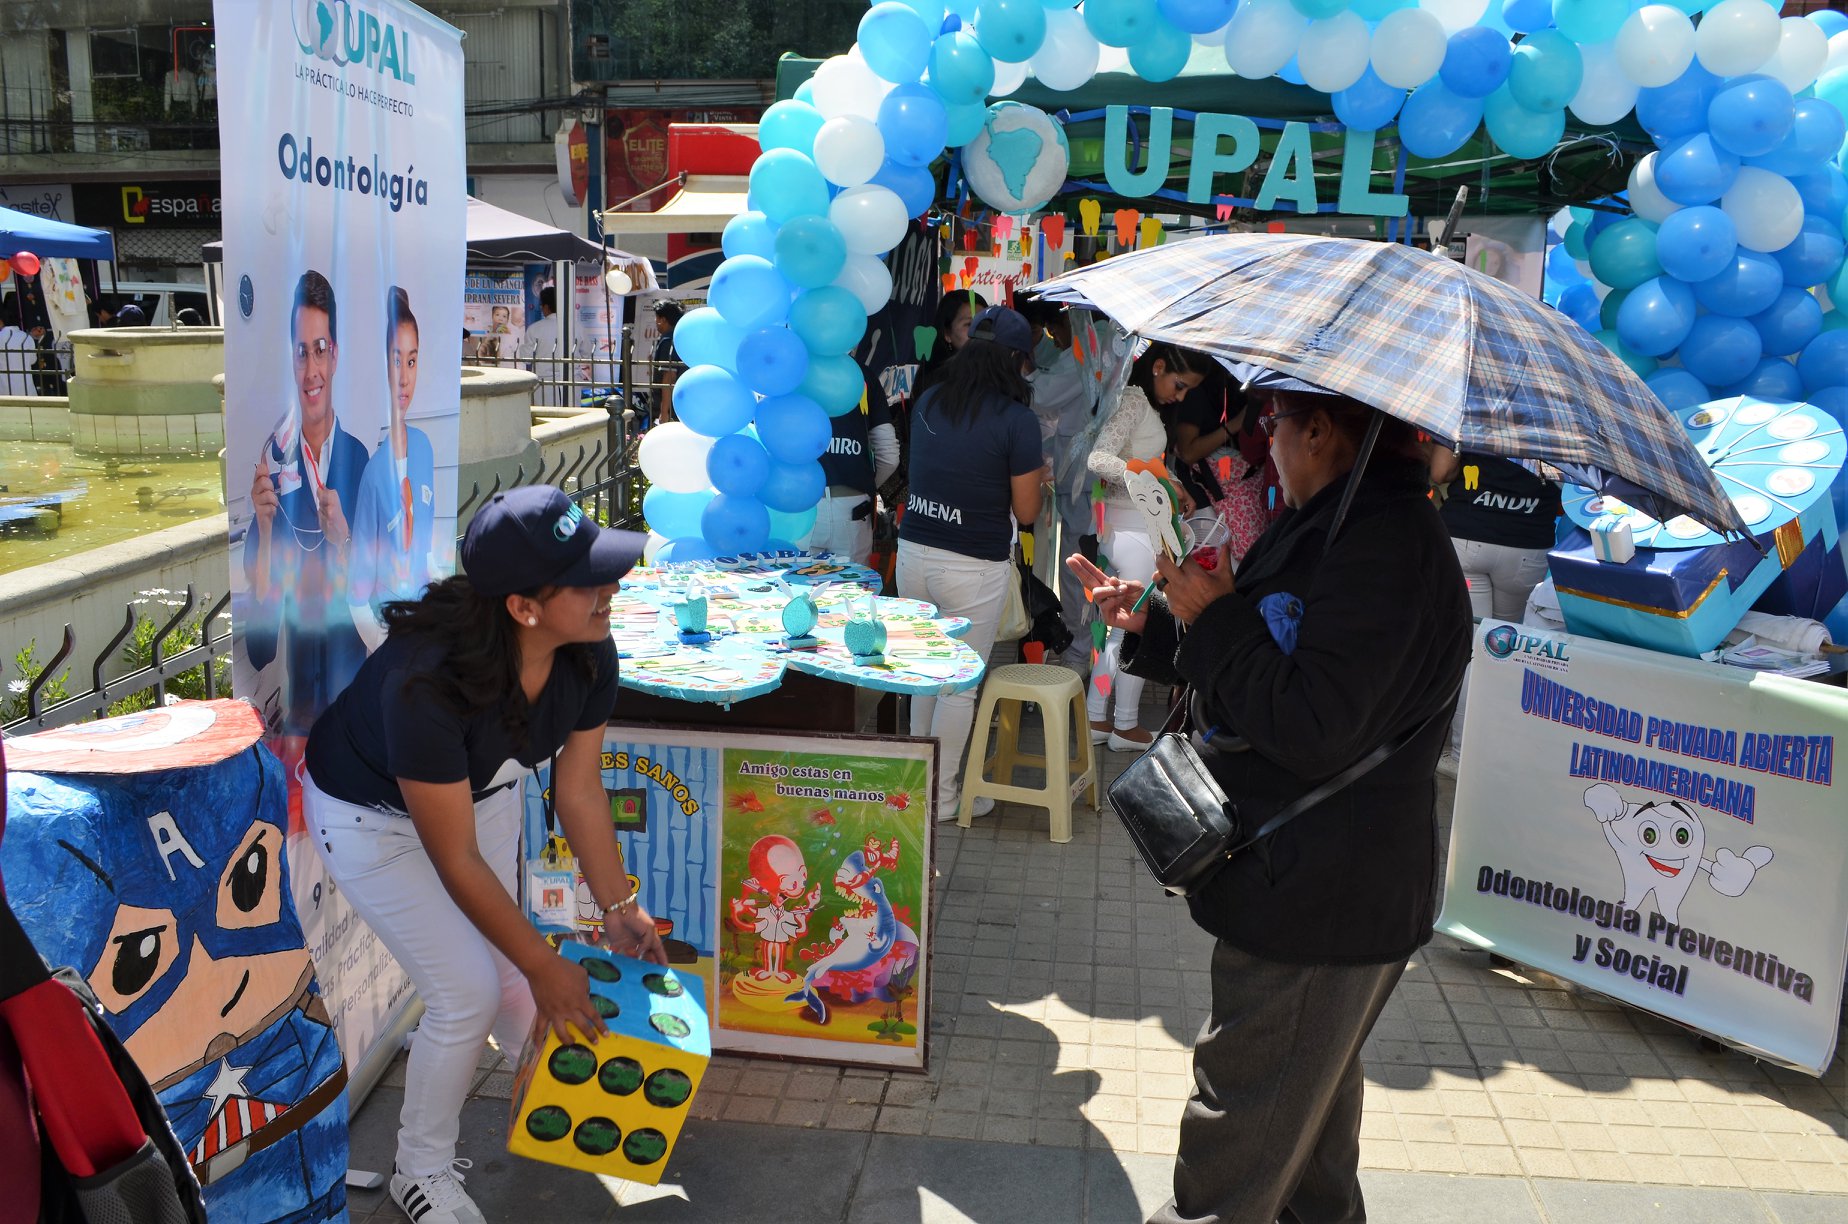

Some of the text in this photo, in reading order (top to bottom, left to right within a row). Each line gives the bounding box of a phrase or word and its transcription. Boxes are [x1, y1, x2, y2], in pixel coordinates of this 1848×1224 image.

[344, 1, 415, 86] UPAL
[295, 62, 414, 117] LA PRÁCTICA LO HACE PERFECTO
[278, 132, 428, 213] Odontología
[629, 139, 665, 153] ELITE
[1104, 105, 1409, 217] UPAL
[465, 294, 492, 303] PRANA
[971, 269, 1024, 286] xtiend
[827, 437, 862, 455] MIRO
[1473, 491, 1540, 514] ANDY
[1509, 633, 1570, 662] UPAL
[1520, 667, 1834, 786] UNIVERSIDAD PRIVADA ABIERTA
[600, 752, 699, 816] ES SANOS
[739, 761, 852, 780] Amigo estas en
[776, 783, 885, 802] buenas manos
[1569, 742, 1756, 825] LATINOAMERICANA
[147, 809, 205, 881] A
[313, 882, 322, 910] 9
[310, 911, 348, 963] alidad
[337, 930, 377, 983] Práctica
[1476, 865, 1814, 1003] Odontología Preventiva
[341, 951, 394, 1018] Personaliz
[1573, 934, 1689, 998] y Social
[388, 976, 412, 1010] www.up
